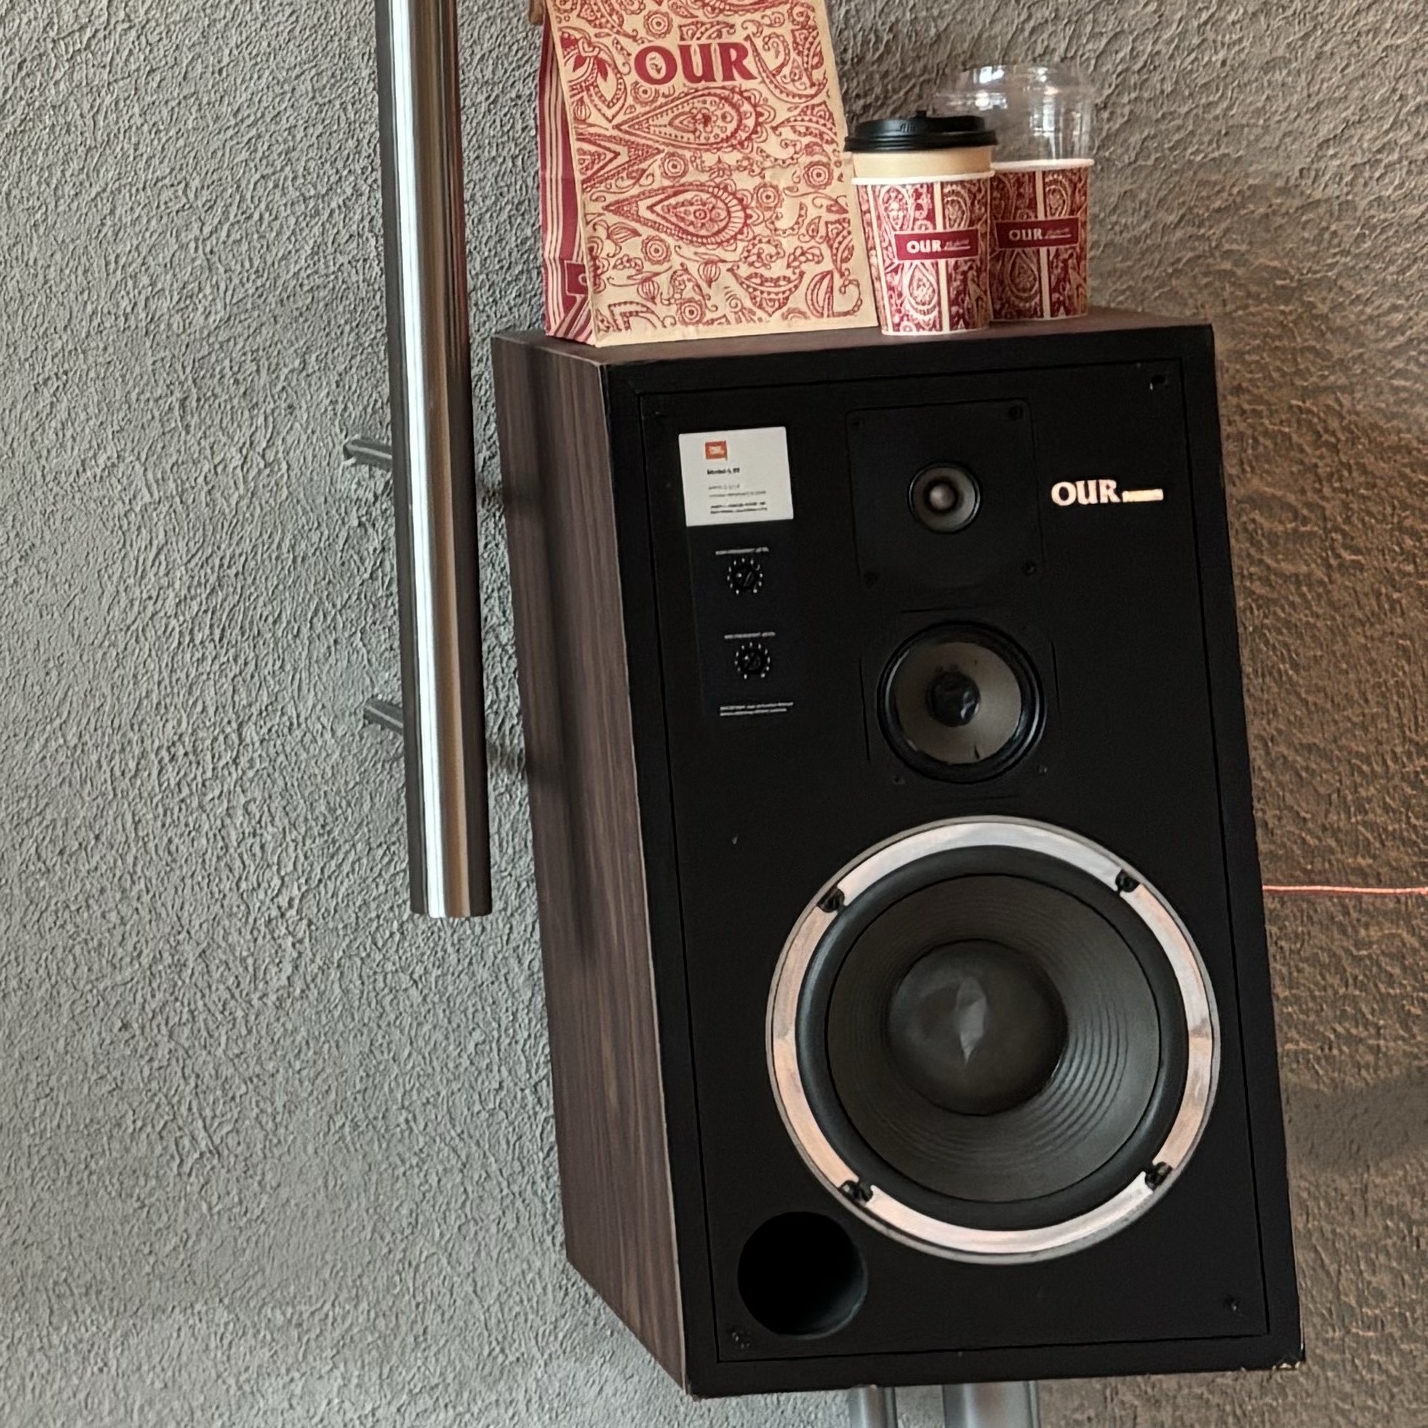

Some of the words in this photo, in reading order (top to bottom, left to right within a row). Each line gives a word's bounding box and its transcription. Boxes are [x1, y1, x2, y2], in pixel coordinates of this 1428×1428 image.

[634, 40, 757, 86] OUR
[1009, 227, 1043, 242] OUR
[906, 239, 942, 254] OUR
[1051, 479, 1122, 506] OUR
